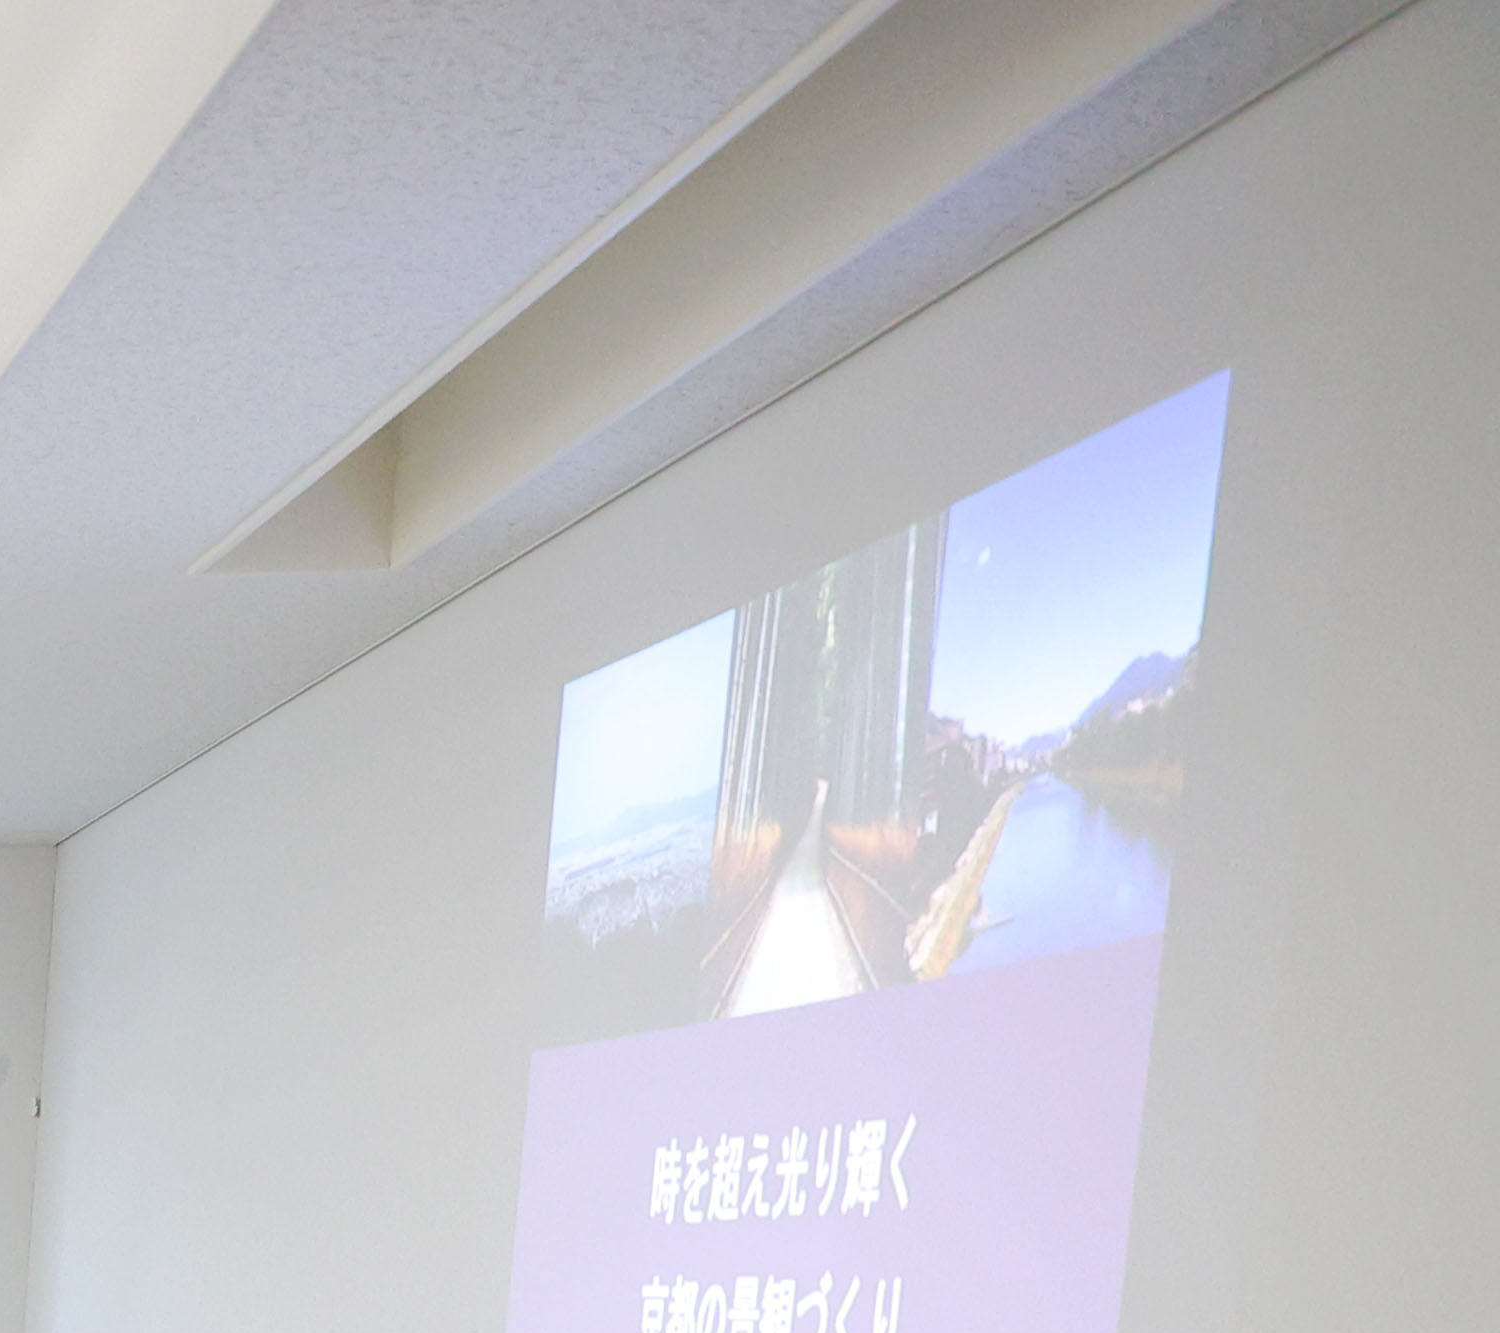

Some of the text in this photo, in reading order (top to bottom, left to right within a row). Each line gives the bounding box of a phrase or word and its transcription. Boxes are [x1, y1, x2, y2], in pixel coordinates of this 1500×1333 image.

[649, 1113, 917, 1225] 時を超え光り輝く
